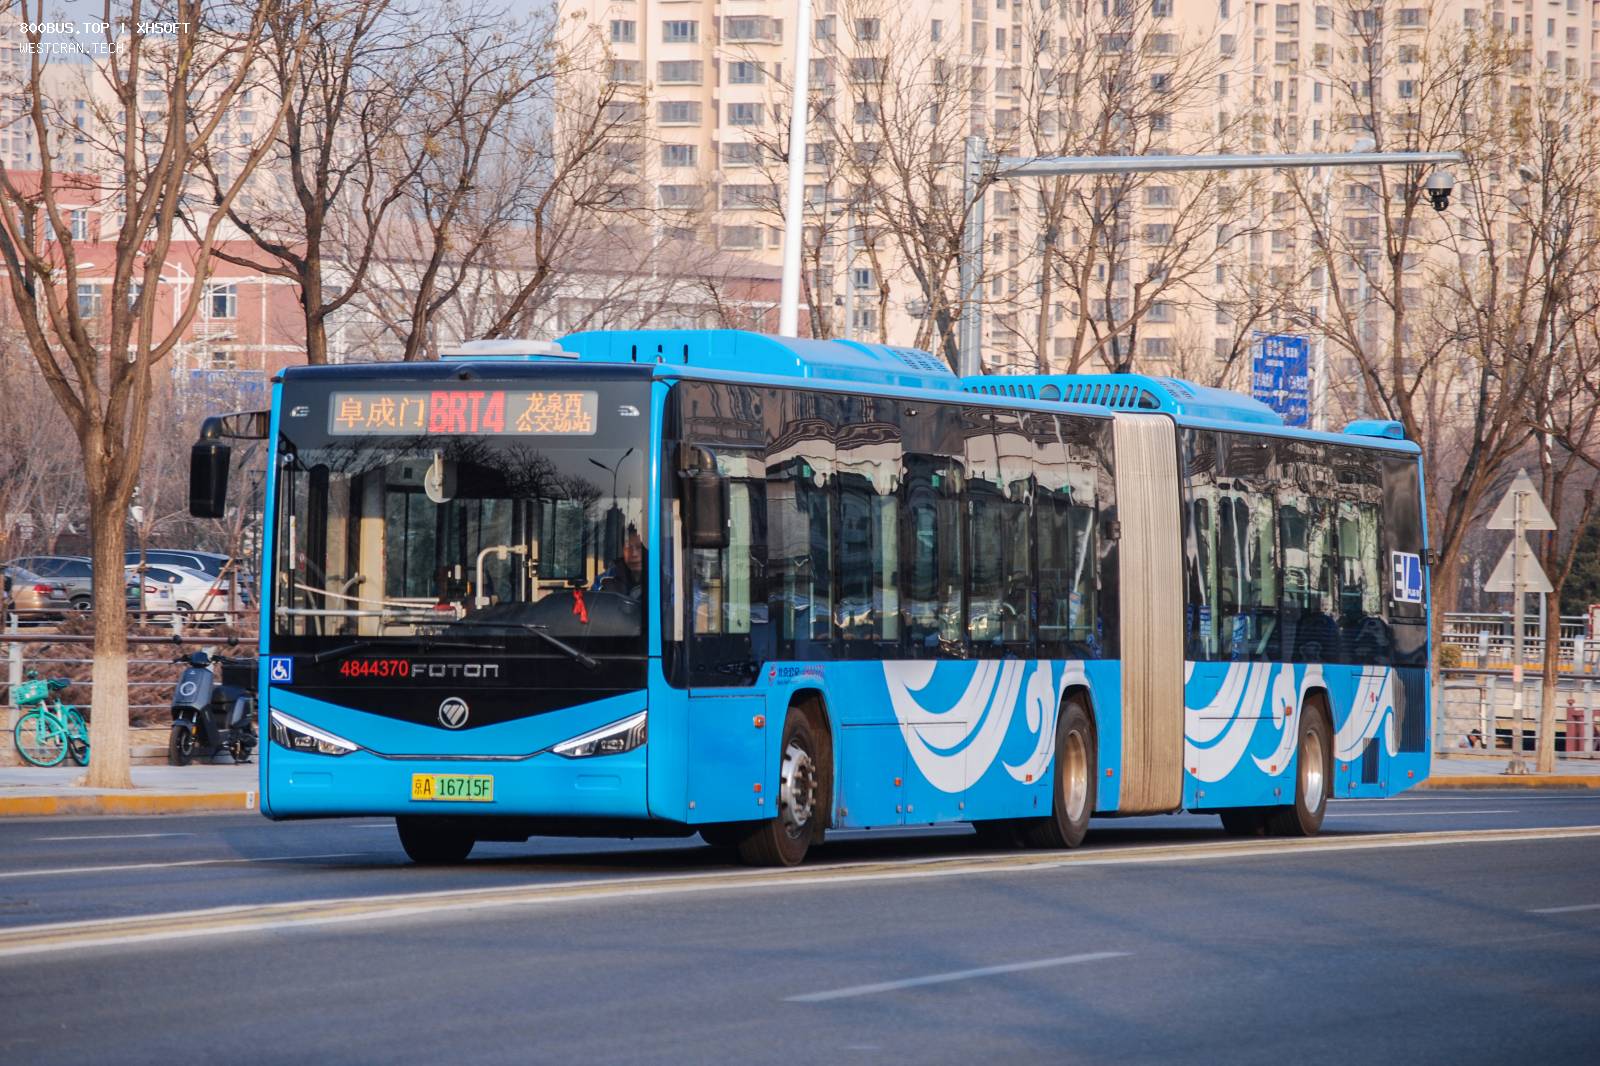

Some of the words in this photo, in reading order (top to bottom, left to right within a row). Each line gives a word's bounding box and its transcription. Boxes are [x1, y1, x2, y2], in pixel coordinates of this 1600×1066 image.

[335, 397, 425, 428] 阜成门
[427, 391, 505, 433] BRT4
[526, 392, 585, 416] 龙泉西
[515, 411, 593, 433] 公交场站
[339, 660, 409, 677] 4844370
[411, 663, 499, 678] FOTON
[439, 778, 491, 797] 16715F
